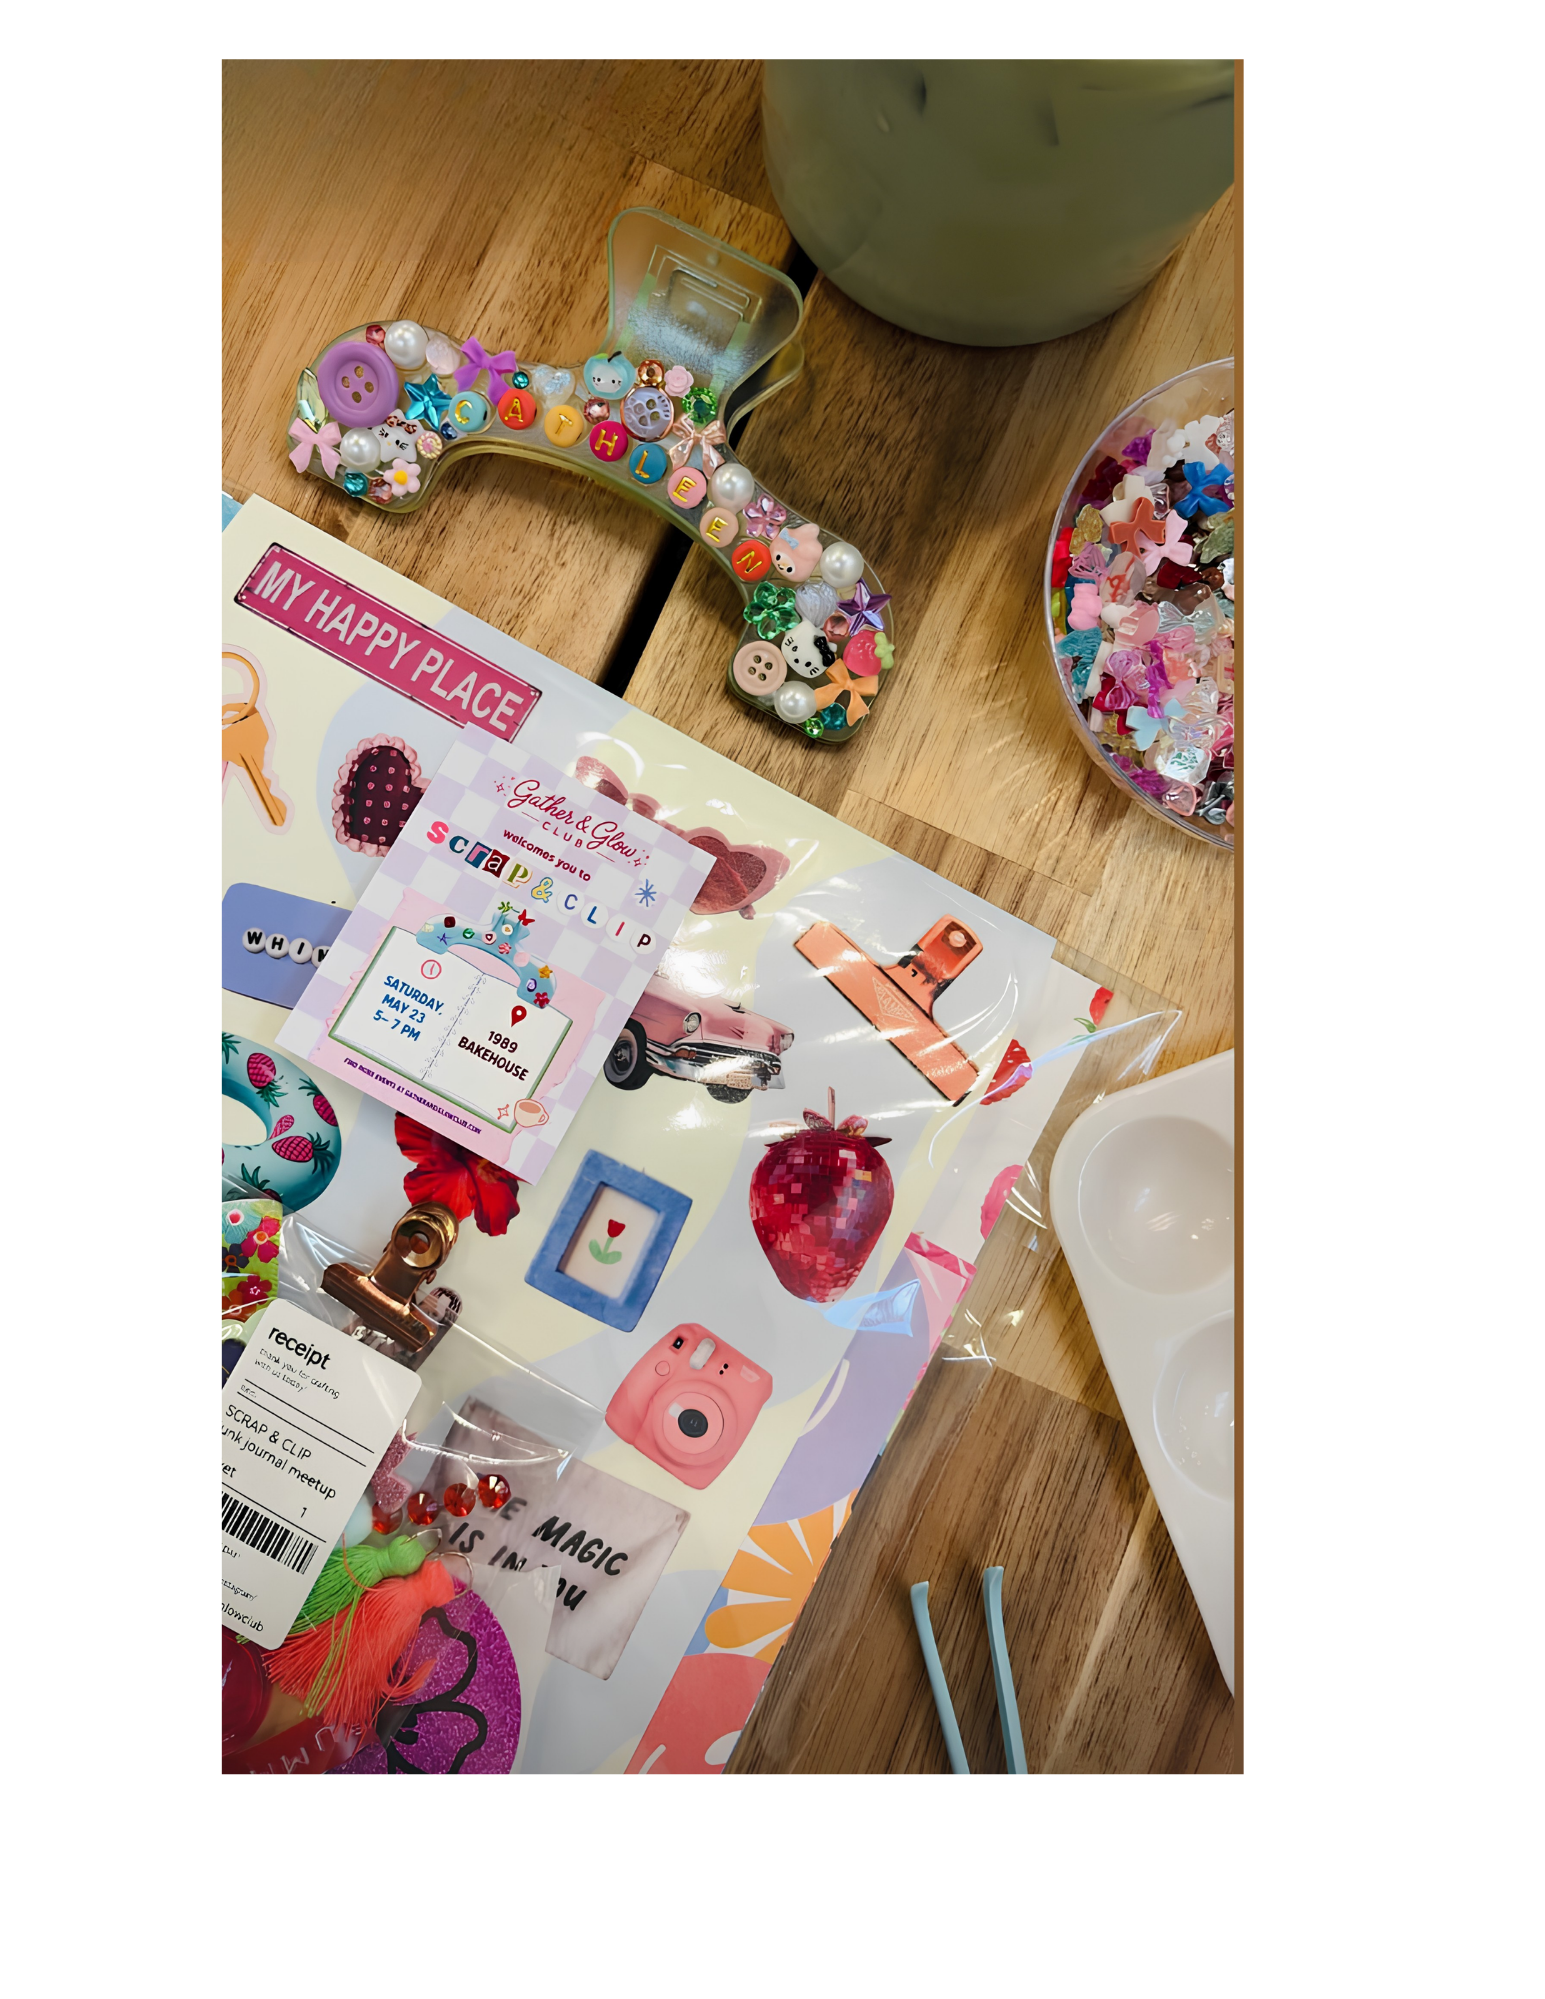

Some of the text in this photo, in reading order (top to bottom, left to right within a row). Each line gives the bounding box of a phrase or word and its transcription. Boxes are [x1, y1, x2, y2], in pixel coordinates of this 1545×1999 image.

[454, 397, 763, 574] CATHLEEN
[254, 561, 524, 732] MY HAPPY PLACE
[507, 779, 638, 858] Gather & Glow
[542, 821, 583, 848] CLUB
[503, 829, 592, 882] welcomes you to
[531, 877, 553, 903] &
[563, 893, 652, 949] CLIP
[381, 993, 426, 1024] MAY 23
[384, 975, 444, 1016] SATURDAY,
[391, 1018, 401, 1030] 7
[400, 1024, 421, 1042] PM
[487, 1030, 518, 1053] 1989
[458, 1036, 529, 1081] BAKEHOUSE
[268, 1327, 331, 1370] receipt
[225, 1404, 312, 1460] SCRAP & CLIP
[221, 1421, 336, 1501] unk journal meetup
[300, 1506, 308, 1519] 1
[448, 1521, 528, 1572] IS IN
[531, 1515, 629, 1576] MAGIC
